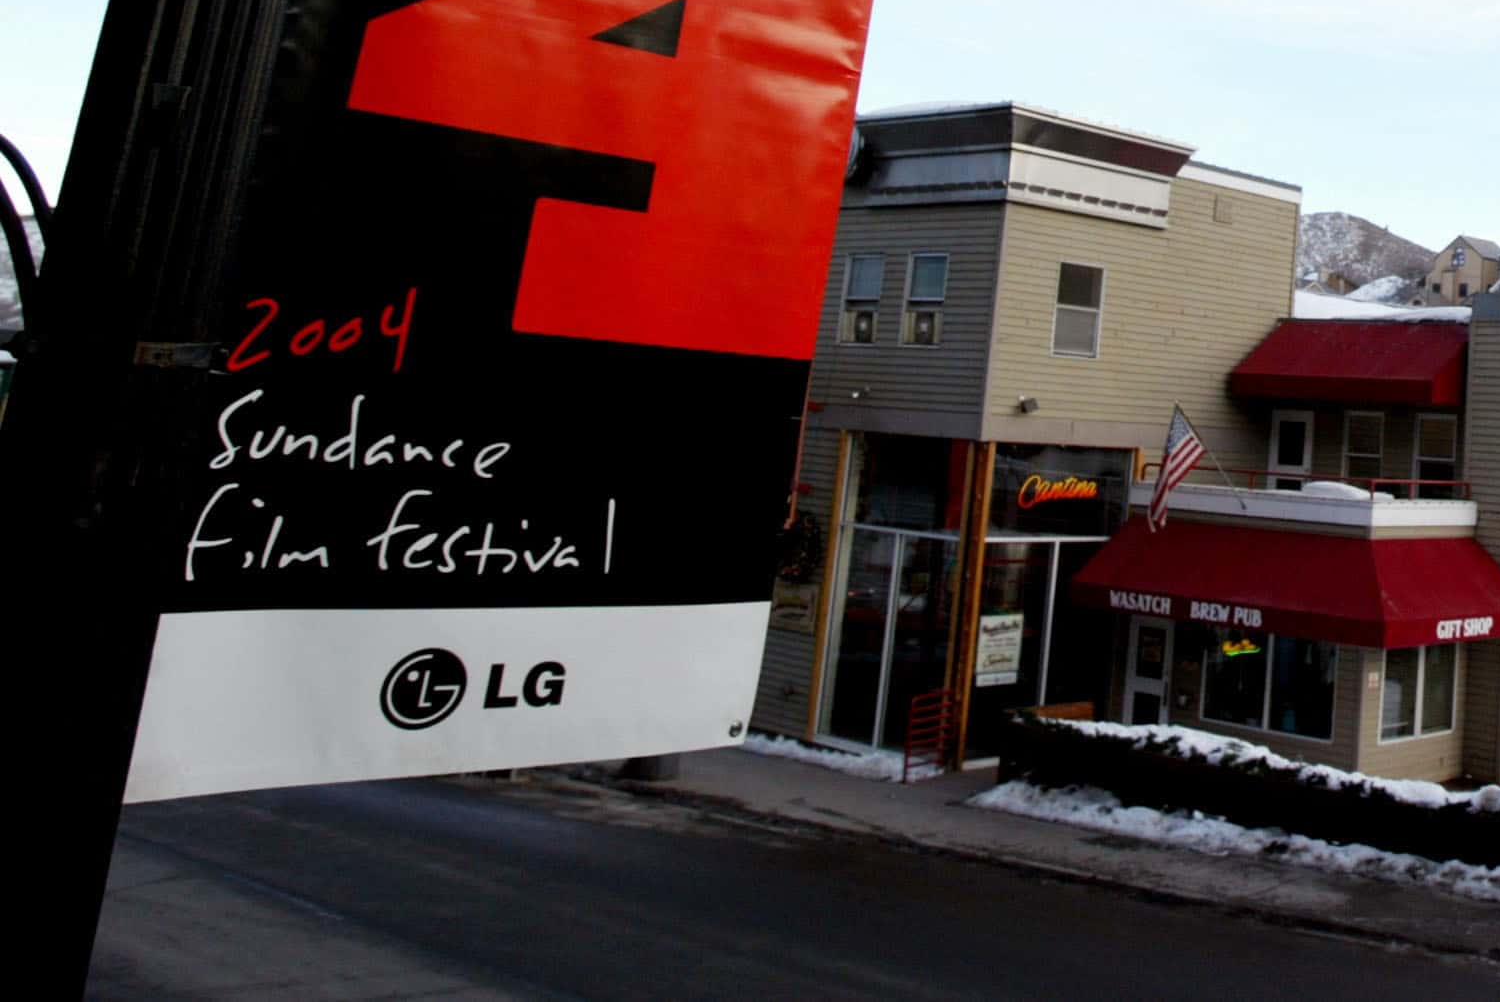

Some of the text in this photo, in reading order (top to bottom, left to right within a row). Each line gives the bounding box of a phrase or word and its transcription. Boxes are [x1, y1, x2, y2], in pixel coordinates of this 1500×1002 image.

[227, 287, 417, 372] 2004
[209, 389, 511, 478] Sundance
[1017, 474, 1098, 510] Cantina
[1110, 589, 1262, 628] WASATCH BREW PUB
[1436, 616, 1493, 639] GIFT SHOP
[483, 661, 566, 709] LG
